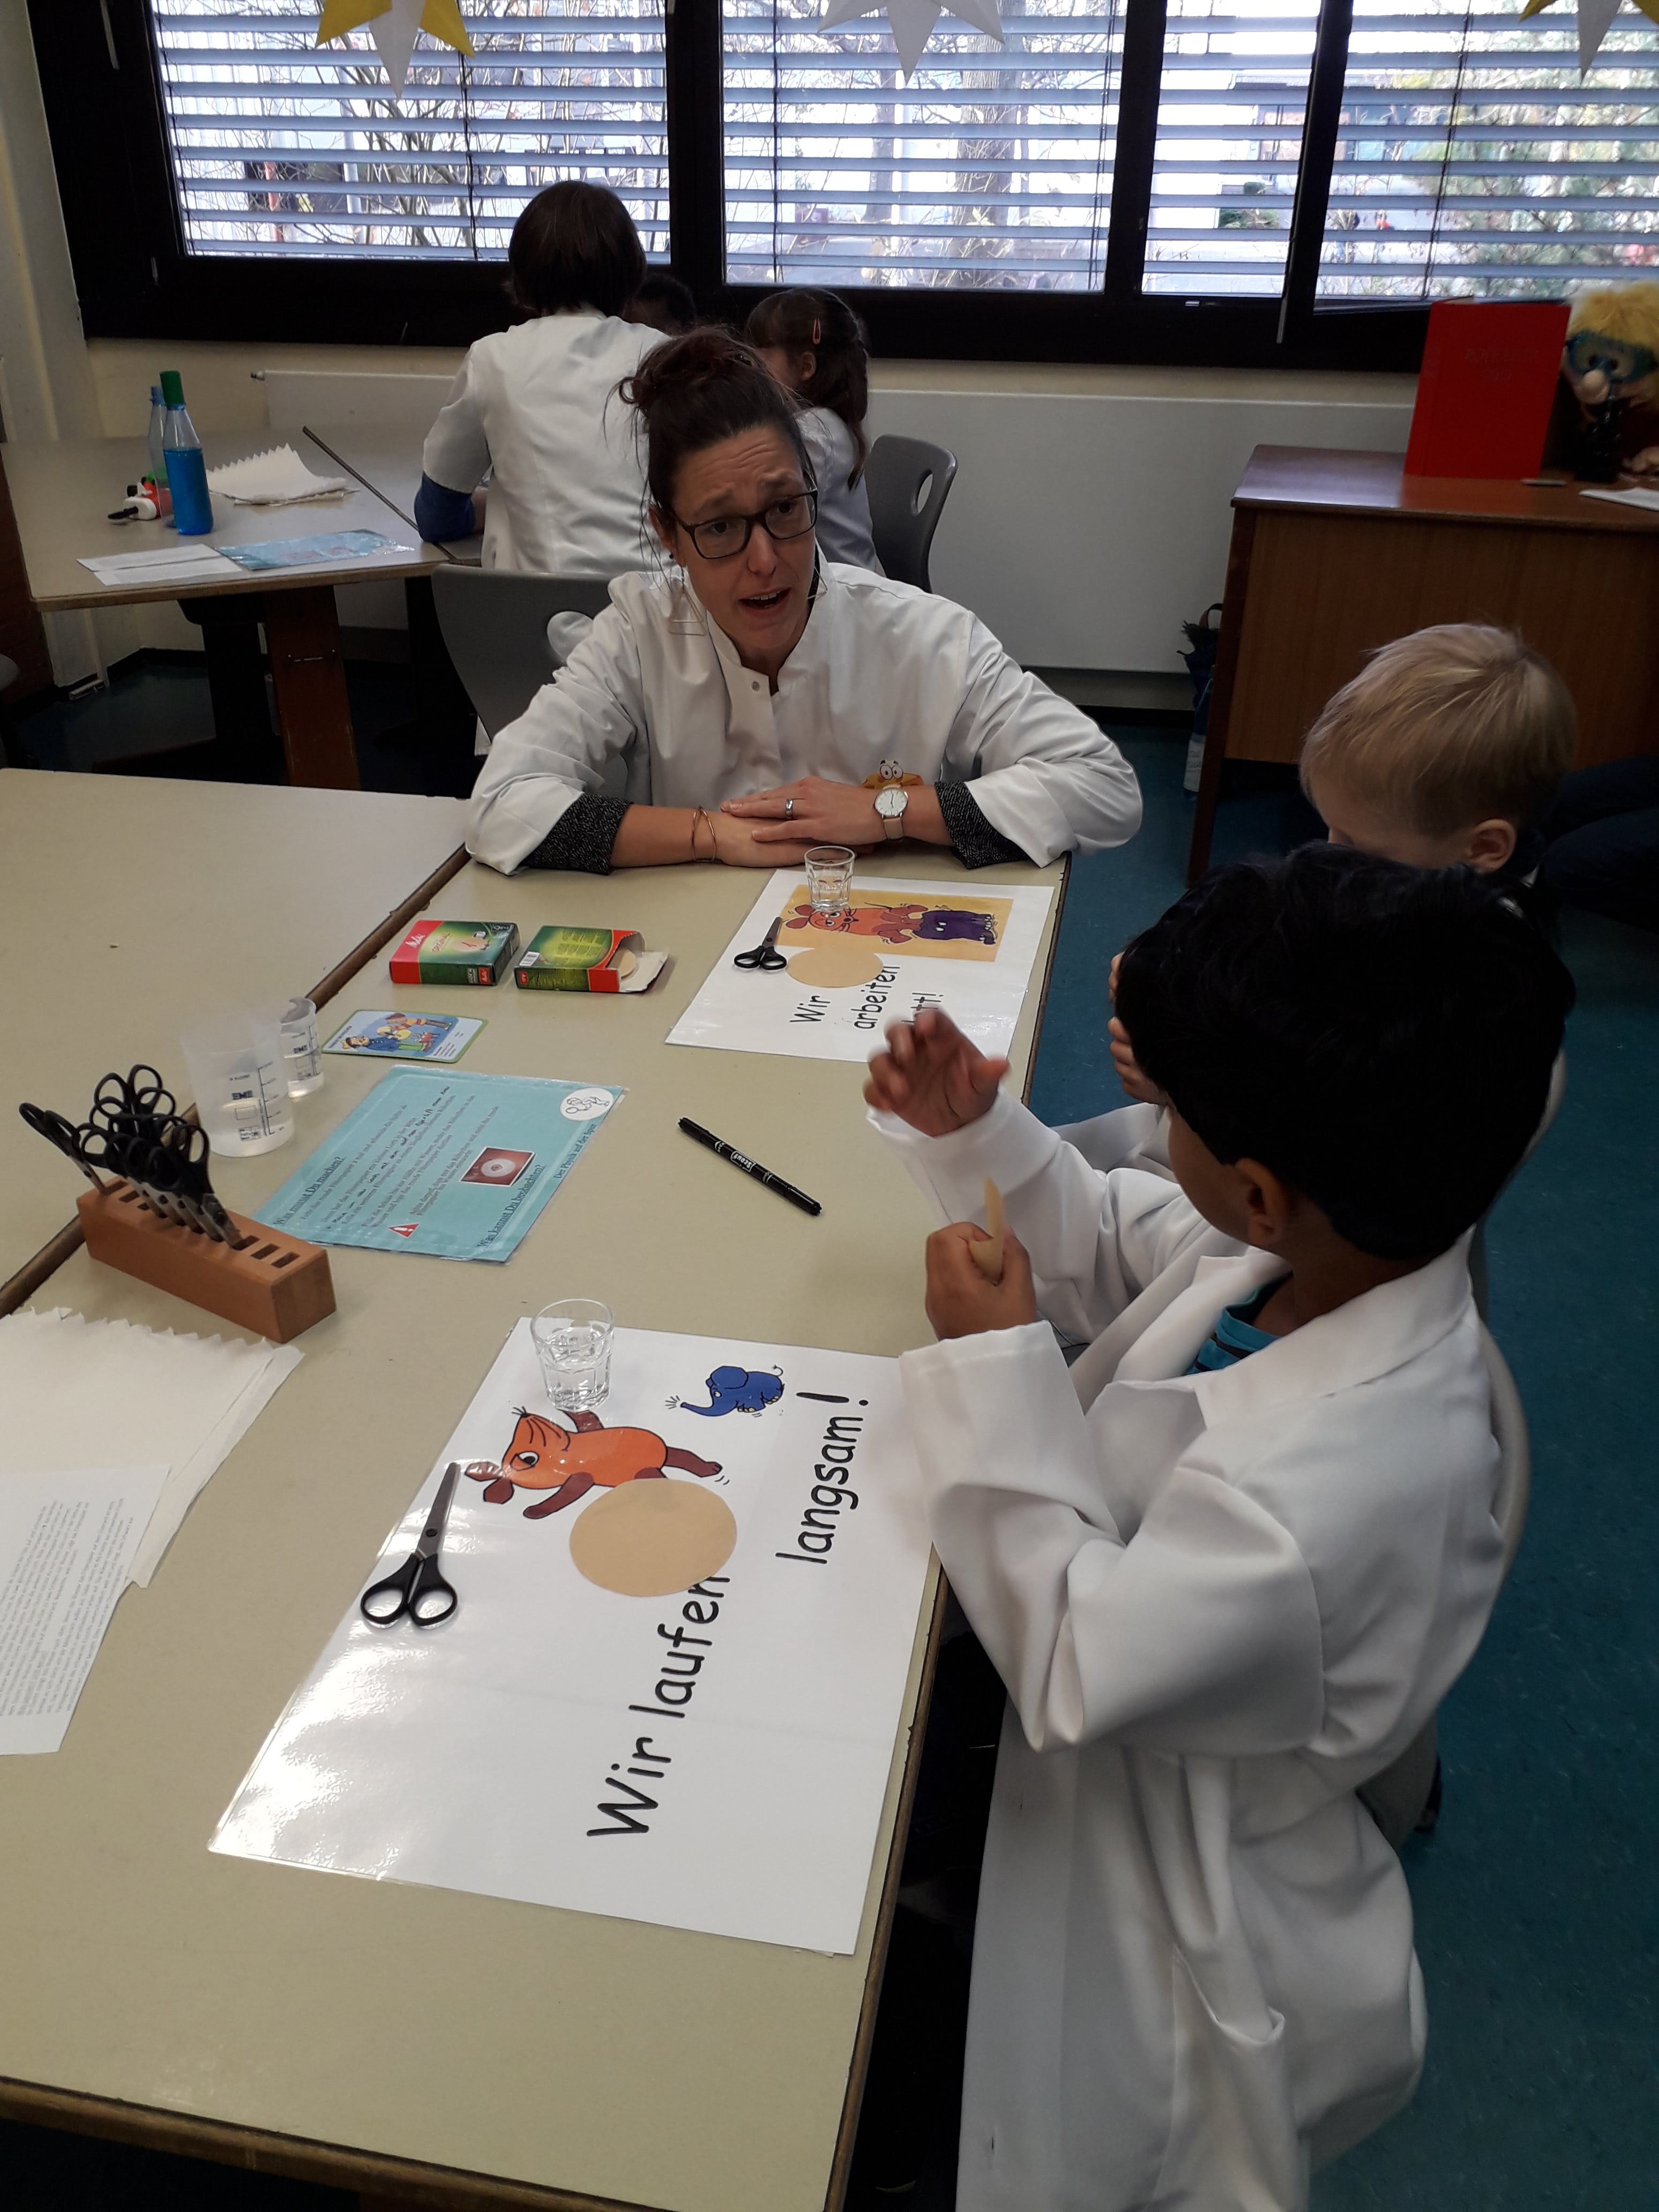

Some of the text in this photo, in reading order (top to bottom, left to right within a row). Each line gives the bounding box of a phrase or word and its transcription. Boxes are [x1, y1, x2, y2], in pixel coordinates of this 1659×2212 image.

[789, 995, 831, 1022] Wir
[850, 966, 901, 1029] arbeiten
[305, 1183, 320, 1194] Du
[317, 1156, 346, 1186] machen?
[733, 1153, 753, 1169] Scout
[477, 1164, 545, 1247] Was kannst Du beobachten?
[775, 1392, 870, 1565] langsam!
[586, 1576, 731, 1837] Wir laufen
